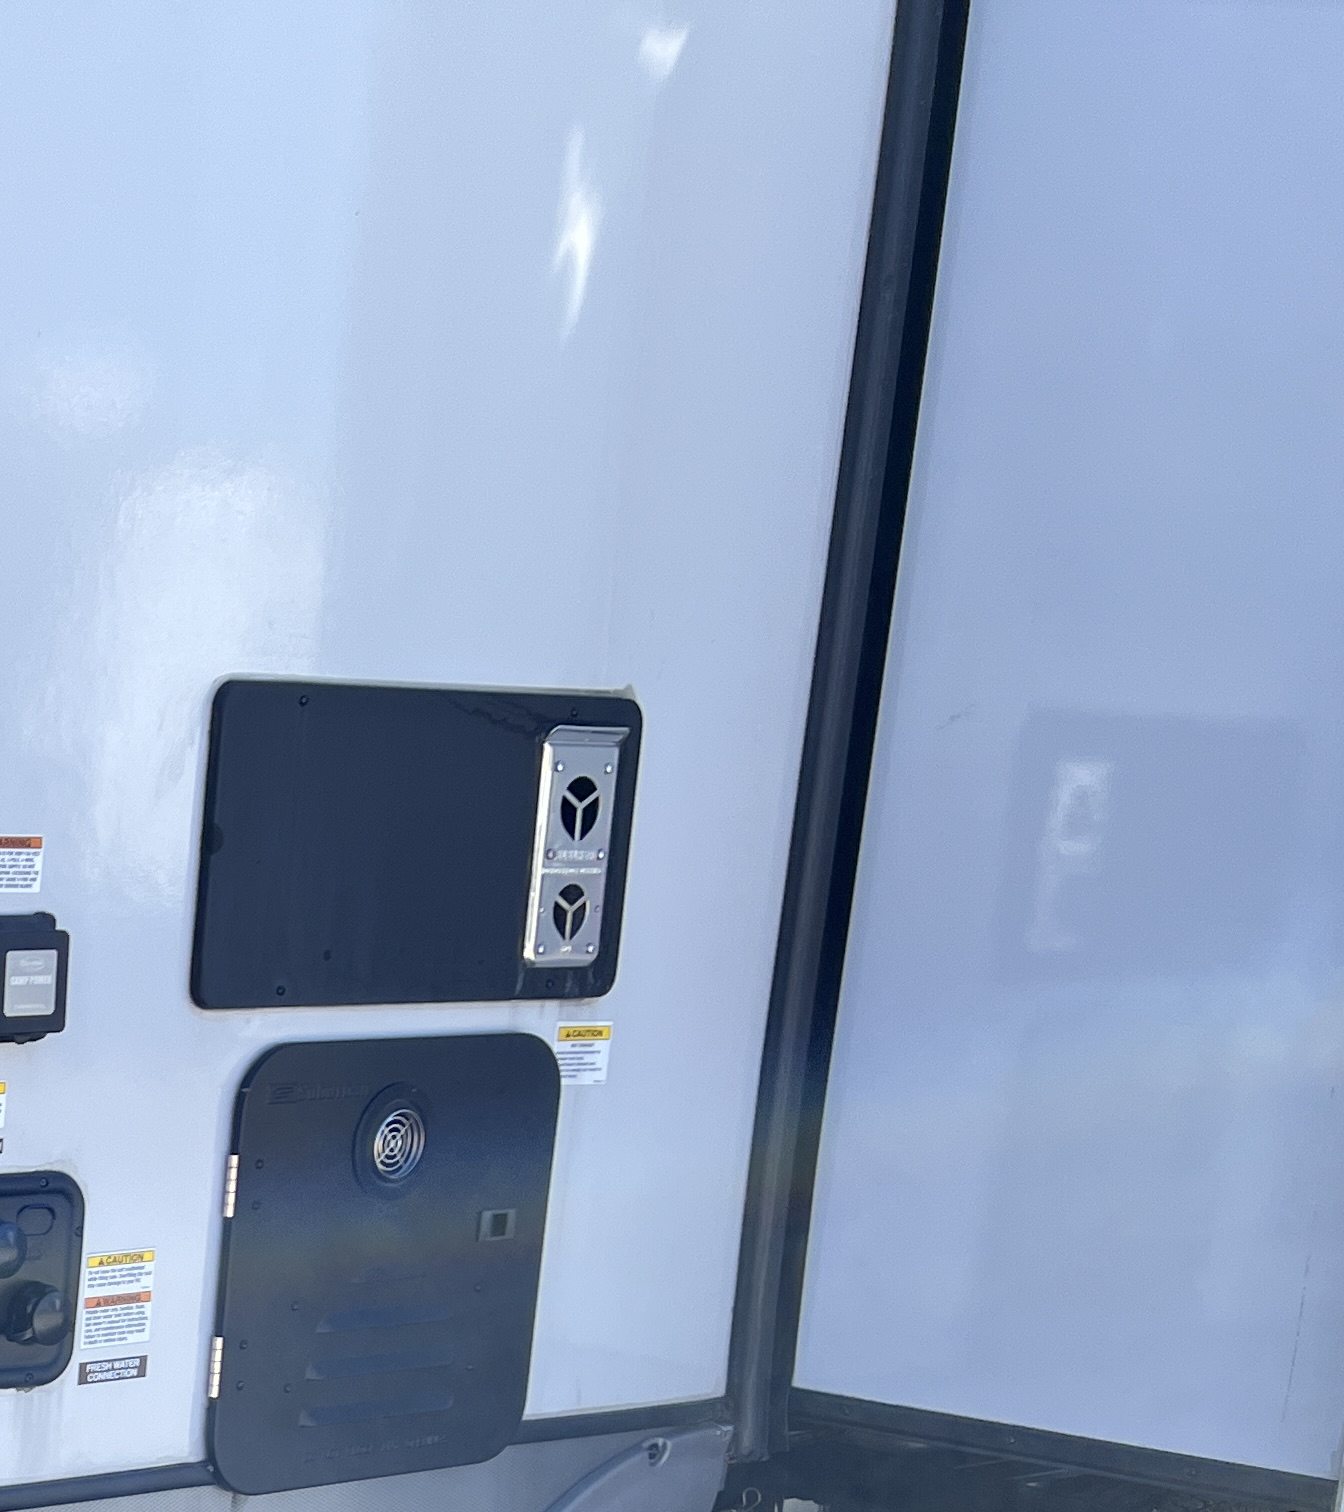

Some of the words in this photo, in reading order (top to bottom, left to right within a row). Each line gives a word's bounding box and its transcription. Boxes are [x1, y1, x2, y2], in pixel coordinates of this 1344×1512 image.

[572, 1029, 603, 1037] CAUTION
[106, 1253, 144, 1265] CAUTION
[86, 1361, 112, 1373] FRESH
[113, 1358, 140, 1369] WATER
[86, 1368, 138, 1382] CONNECTION
